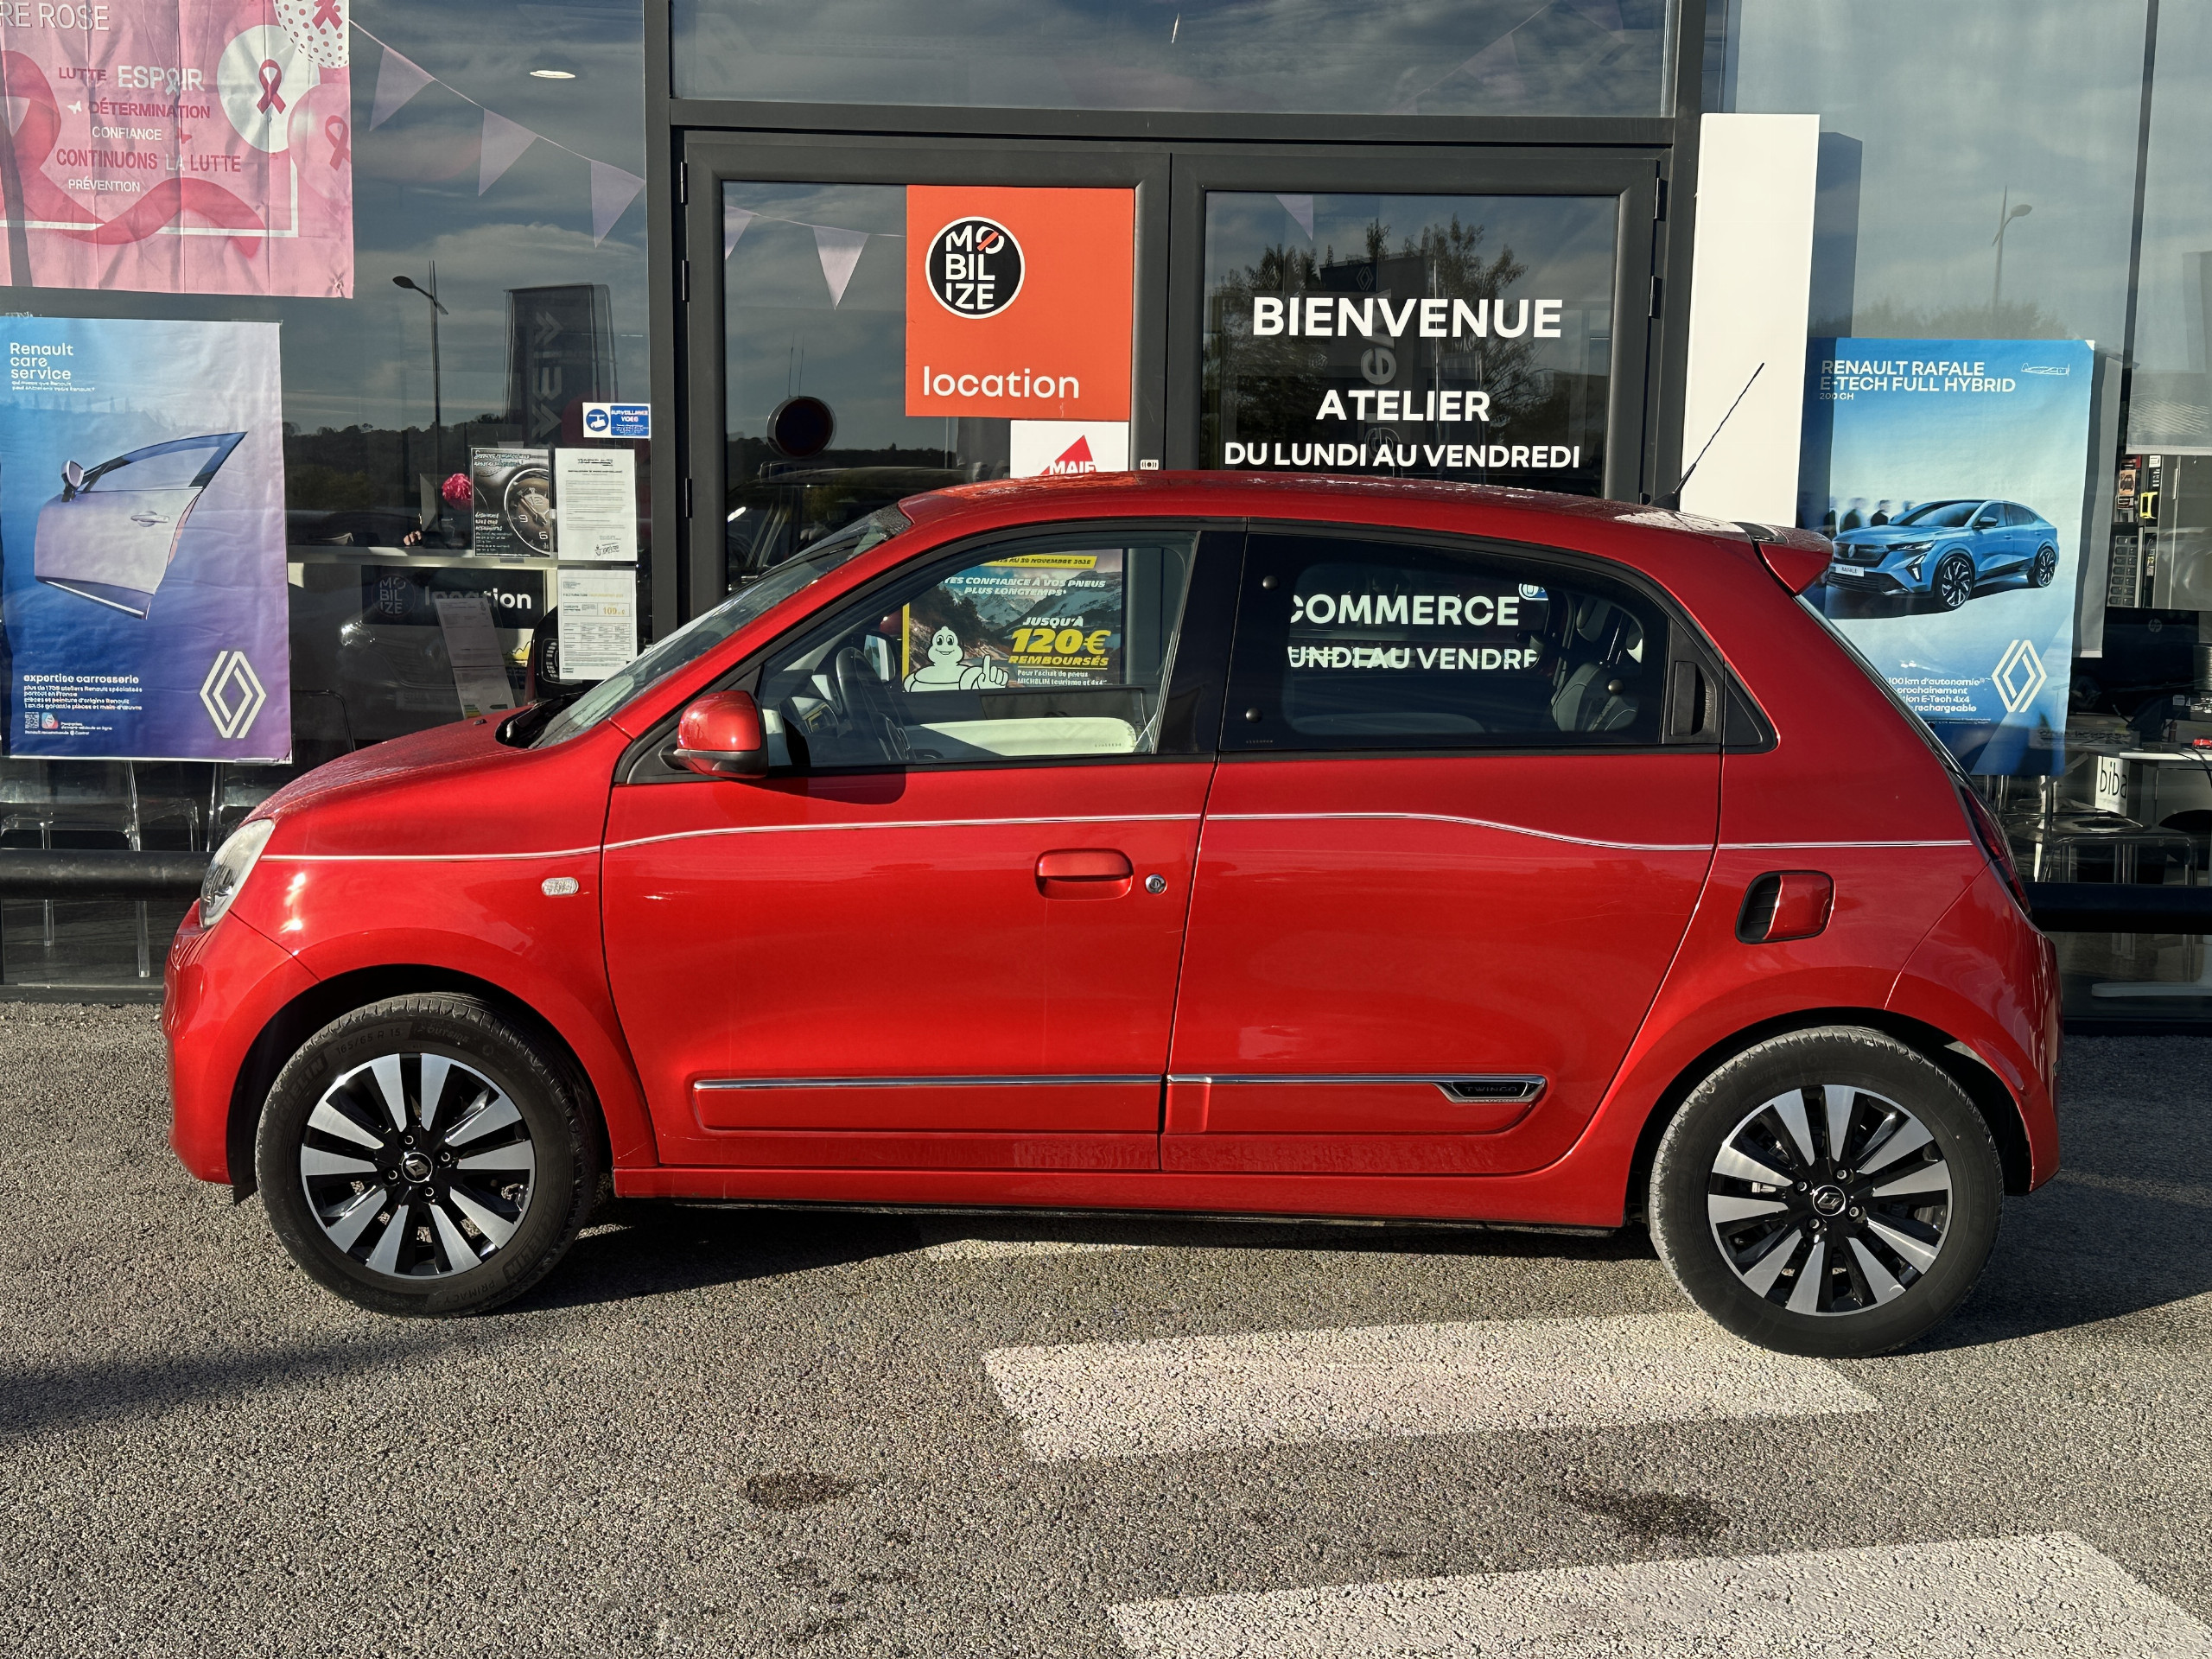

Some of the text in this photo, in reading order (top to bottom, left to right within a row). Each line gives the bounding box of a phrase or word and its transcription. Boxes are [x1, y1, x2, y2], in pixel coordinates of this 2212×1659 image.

[38, 3, 110, 31] ROSE
[59, 67, 107, 82] LUTTE
[88, 97, 211, 119] DÉTERMINATION
[92, 126, 162, 141] CONFIANCE
[56, 148, 241, 172] CONTINUONS LA LUTTE
[68, 176, 141, 193] PRÉVENTION
[1253, 296, 1563, 338] BIENVENUE
[10, 342, 73, 356] Renault
[10, 357, 48, 367] care
[1821, 359, 1985, 376] RENAULT RAFALE
[10, 366, 72, 380] service
[924, 365, 1079, 399] location
[1820, 376, 2016, 392] E-TECH FULL HYBRID
[1316, 390, 1491, 422] ATELIER
[1224, 442, 1580, 468] DU LUNDI AU VENDREDI
[1050, 461, 1096, 475] MAIF
[966, 577, 1031, 587] CONFIANCE
[1033, 577, 1041, 587] À
[1043, 579, 1066, 588] VOS
[1023, 616, 1084, 628] JUSQU'À
[1011, 628, 1112, 655] 120€
[1008, 655, 1109, 666] REMBOURSÉS
[1367, 647, 1410, 670] AU
[23, 673, 139, 683] expertise carrosserie
[1915, 704, 1977, 714] rechargeable
[2100, 756, 2127, 798] biba
